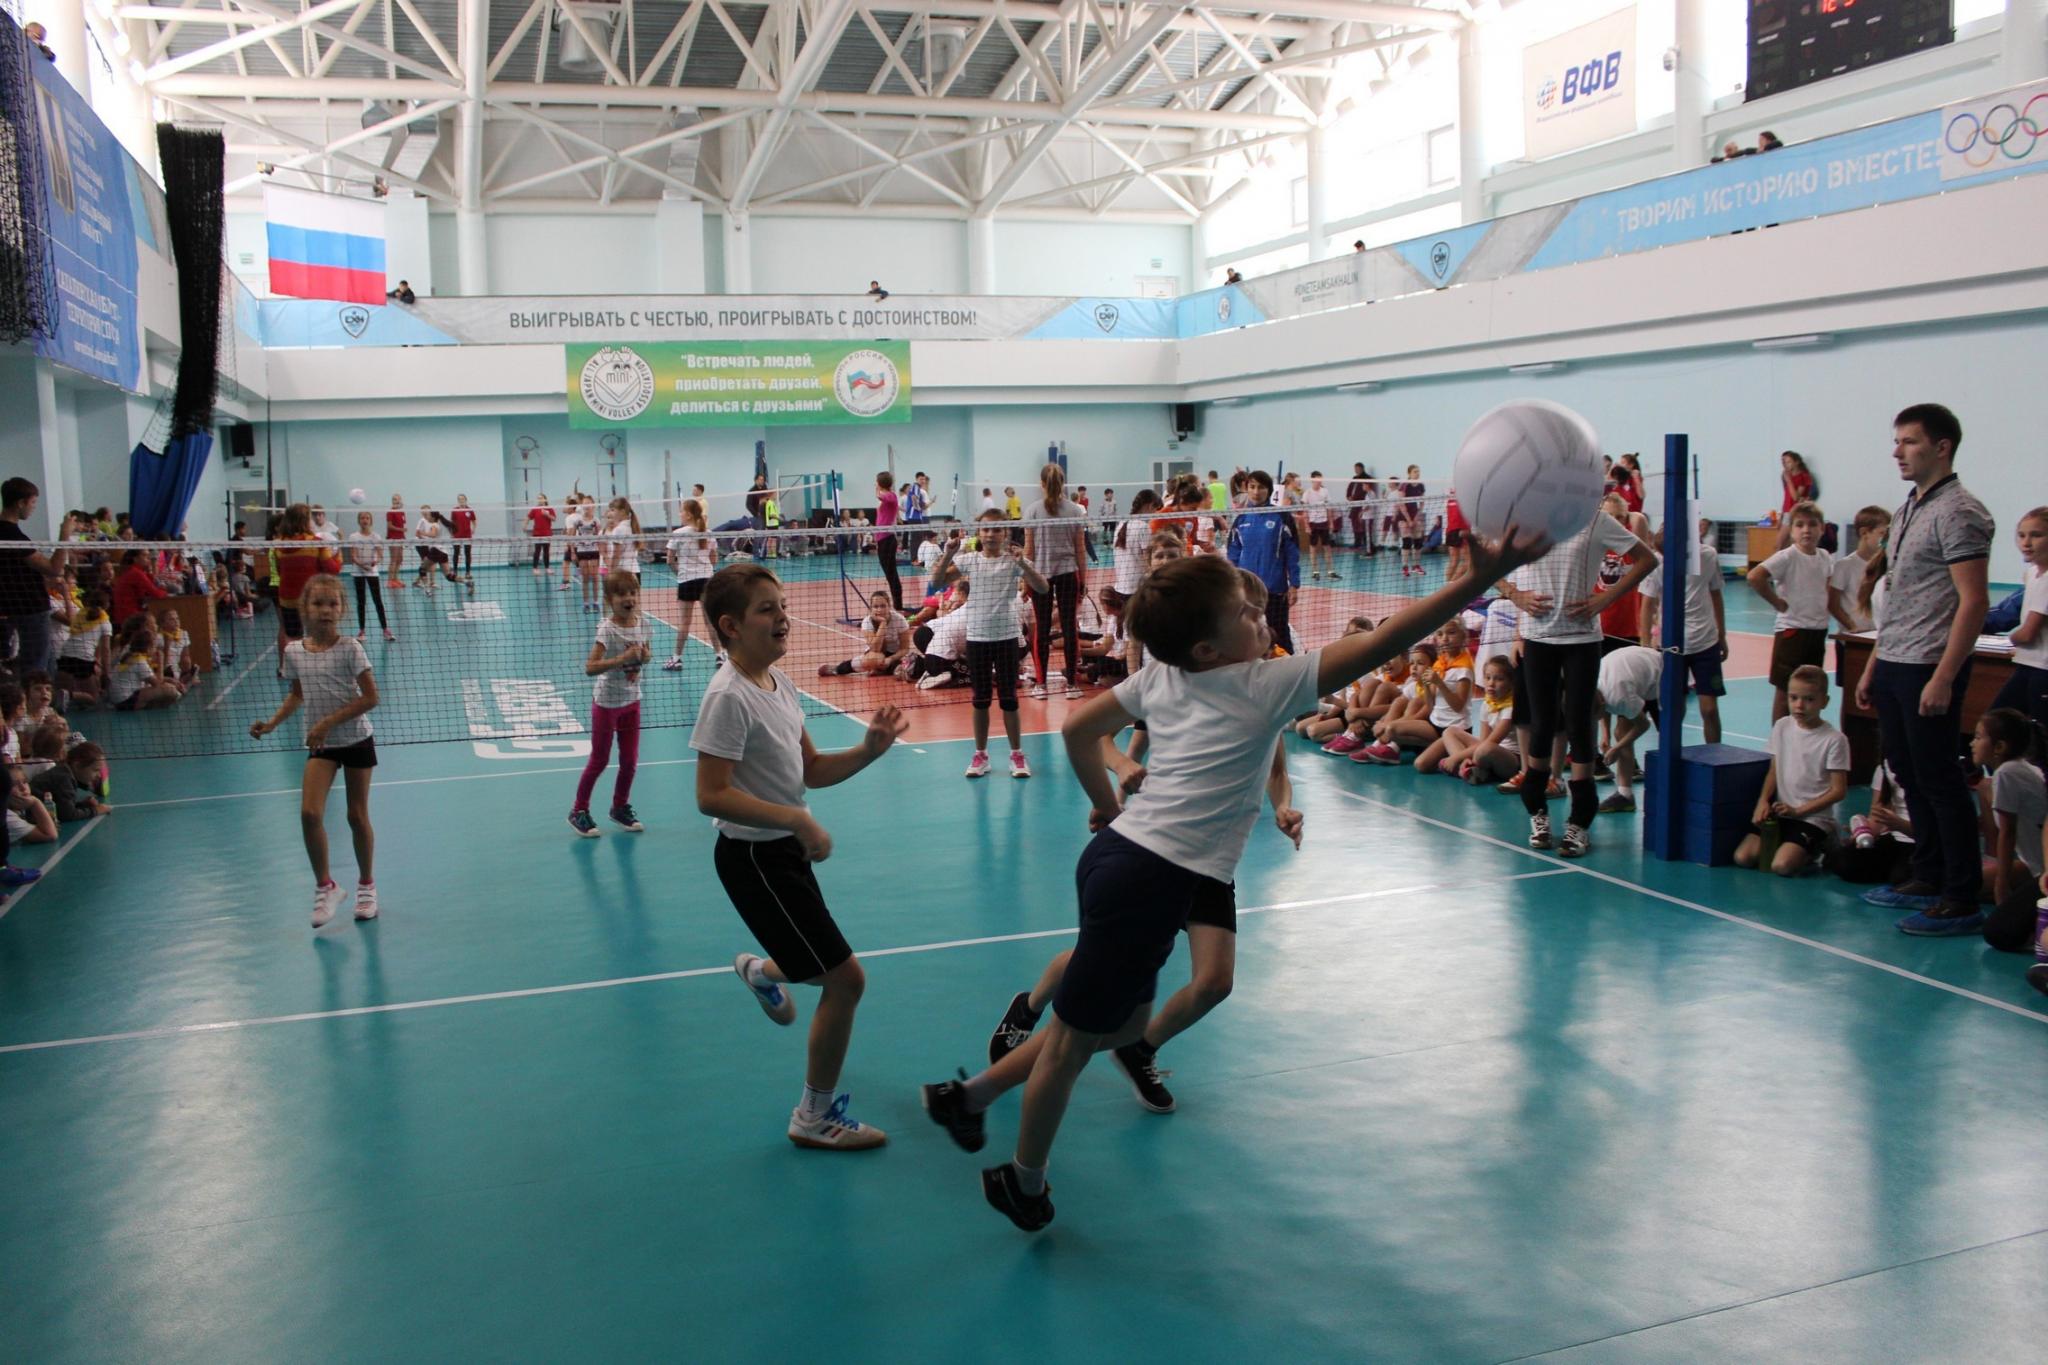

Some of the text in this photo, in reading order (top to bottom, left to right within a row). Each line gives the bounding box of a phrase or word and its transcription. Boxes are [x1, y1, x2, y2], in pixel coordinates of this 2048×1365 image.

[1562, 50, 1622, 105] ВФВ
[1617, 195, 1697, 233] ТВОРИМ
[1704, 169, 1820, 213] ИСТОРИЮ
[509, 310, 977, 328] ВЫИГРЫВАТЬ С ЧЕСТЬЮ, ПРОИГРЫВАТЬ С ДОСТОИНСТВОМ!
[583, 374, 594, 399] JAPAN
[608, 406, 636, 418] VOLLEY
[675, 377, 766, 392] приобретать
[670, 401, 740, 415] делиться
[742, 402, 750, 411] с
